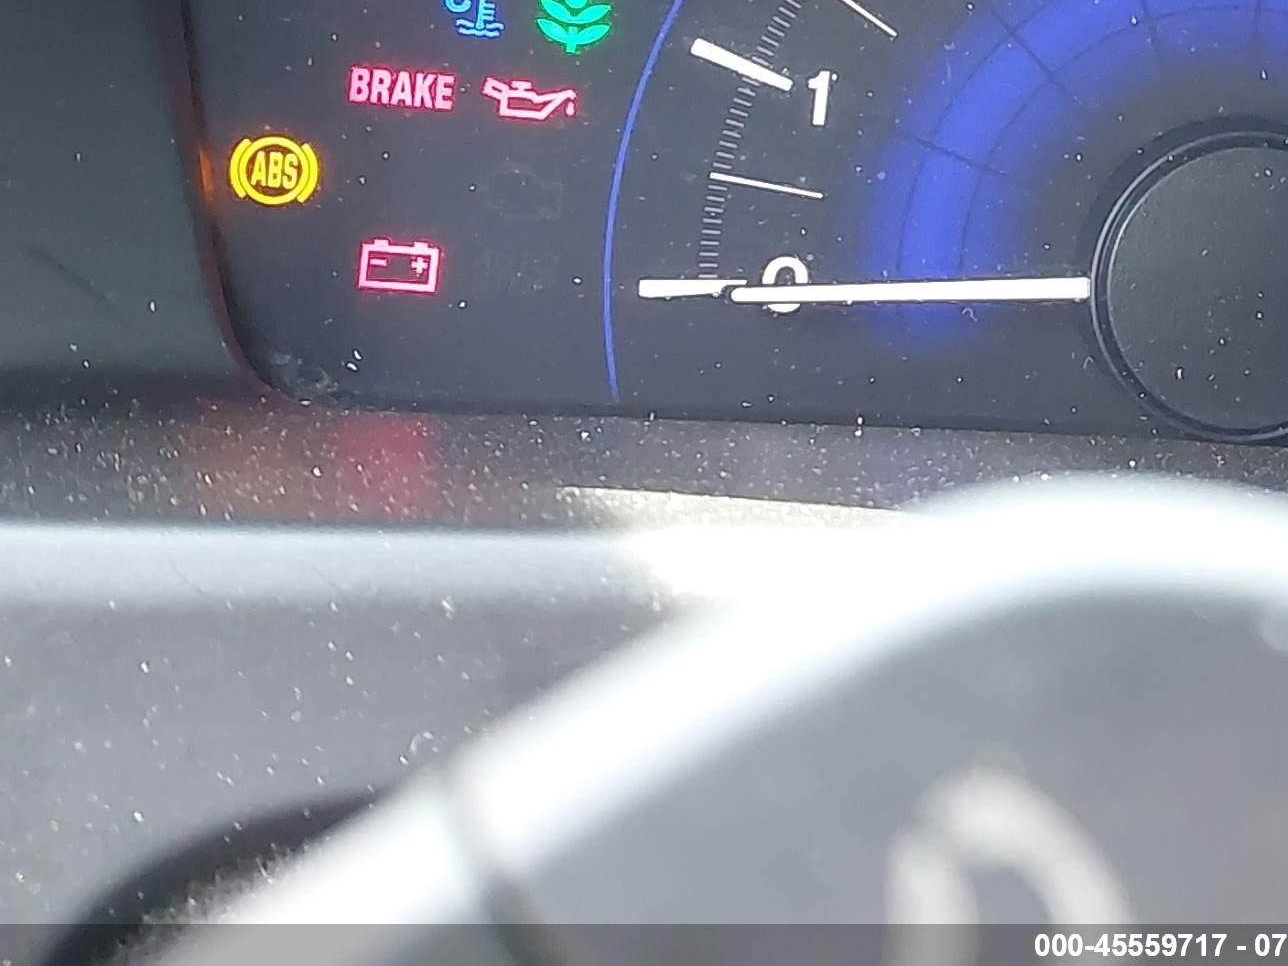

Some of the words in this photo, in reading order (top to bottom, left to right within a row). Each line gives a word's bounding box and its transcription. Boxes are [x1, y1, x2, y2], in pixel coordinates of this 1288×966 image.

[349, 65, 456, 110] BRAKE
[808, 70, 831, 125] 1
[250, 151, 299, 188] ABS
